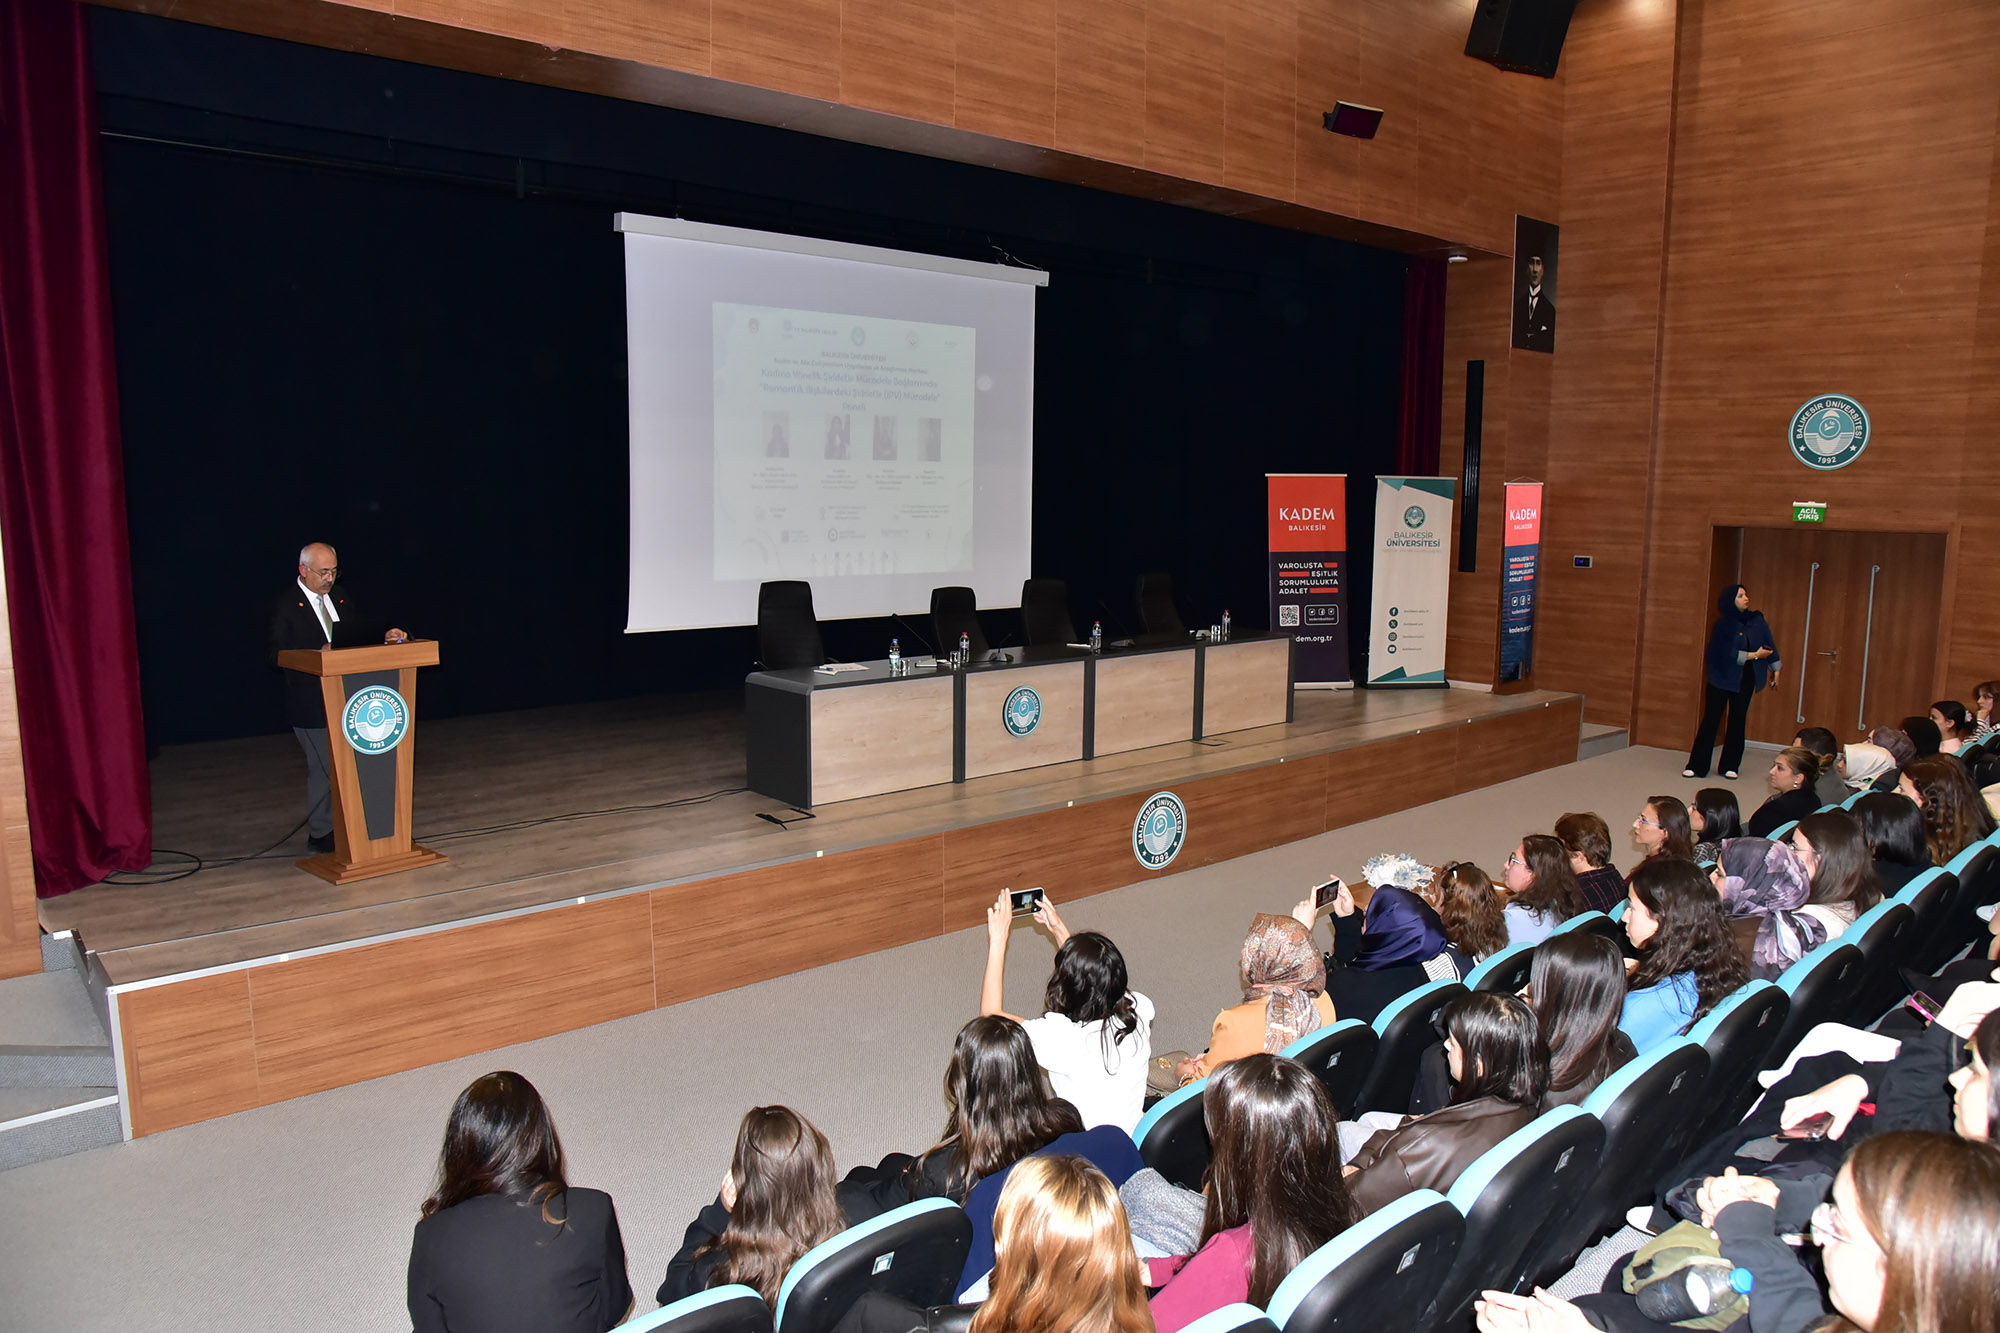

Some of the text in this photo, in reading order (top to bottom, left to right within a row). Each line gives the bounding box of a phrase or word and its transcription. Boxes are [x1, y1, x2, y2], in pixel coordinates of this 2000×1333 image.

[1796, 400, 1862, 439] BALIKESİR ÜNİVERSİTESİ
[1817, 456, 1837, 464] 1992
[1279, 507, 1335, 521] KADEM
[1509, 508, 1537, 521] KADEM
[1288, 523, 1327, 531] BALIKESİR
[1394, 531, 1433, 539] BALIKESİR
[1386, 538, 1441, 548] ÜNİVERSİTESİ
[1295, 635, 1333, 643] dem.org.tr
[348, 691, 403, 729] BALIKESİR ÜNİVERSİTESİ
[370, 741, 385, 749] 1992
[1137, 803, 1156, 845] BALIKESİR
[1150, 851, 1170, 864] 1992
